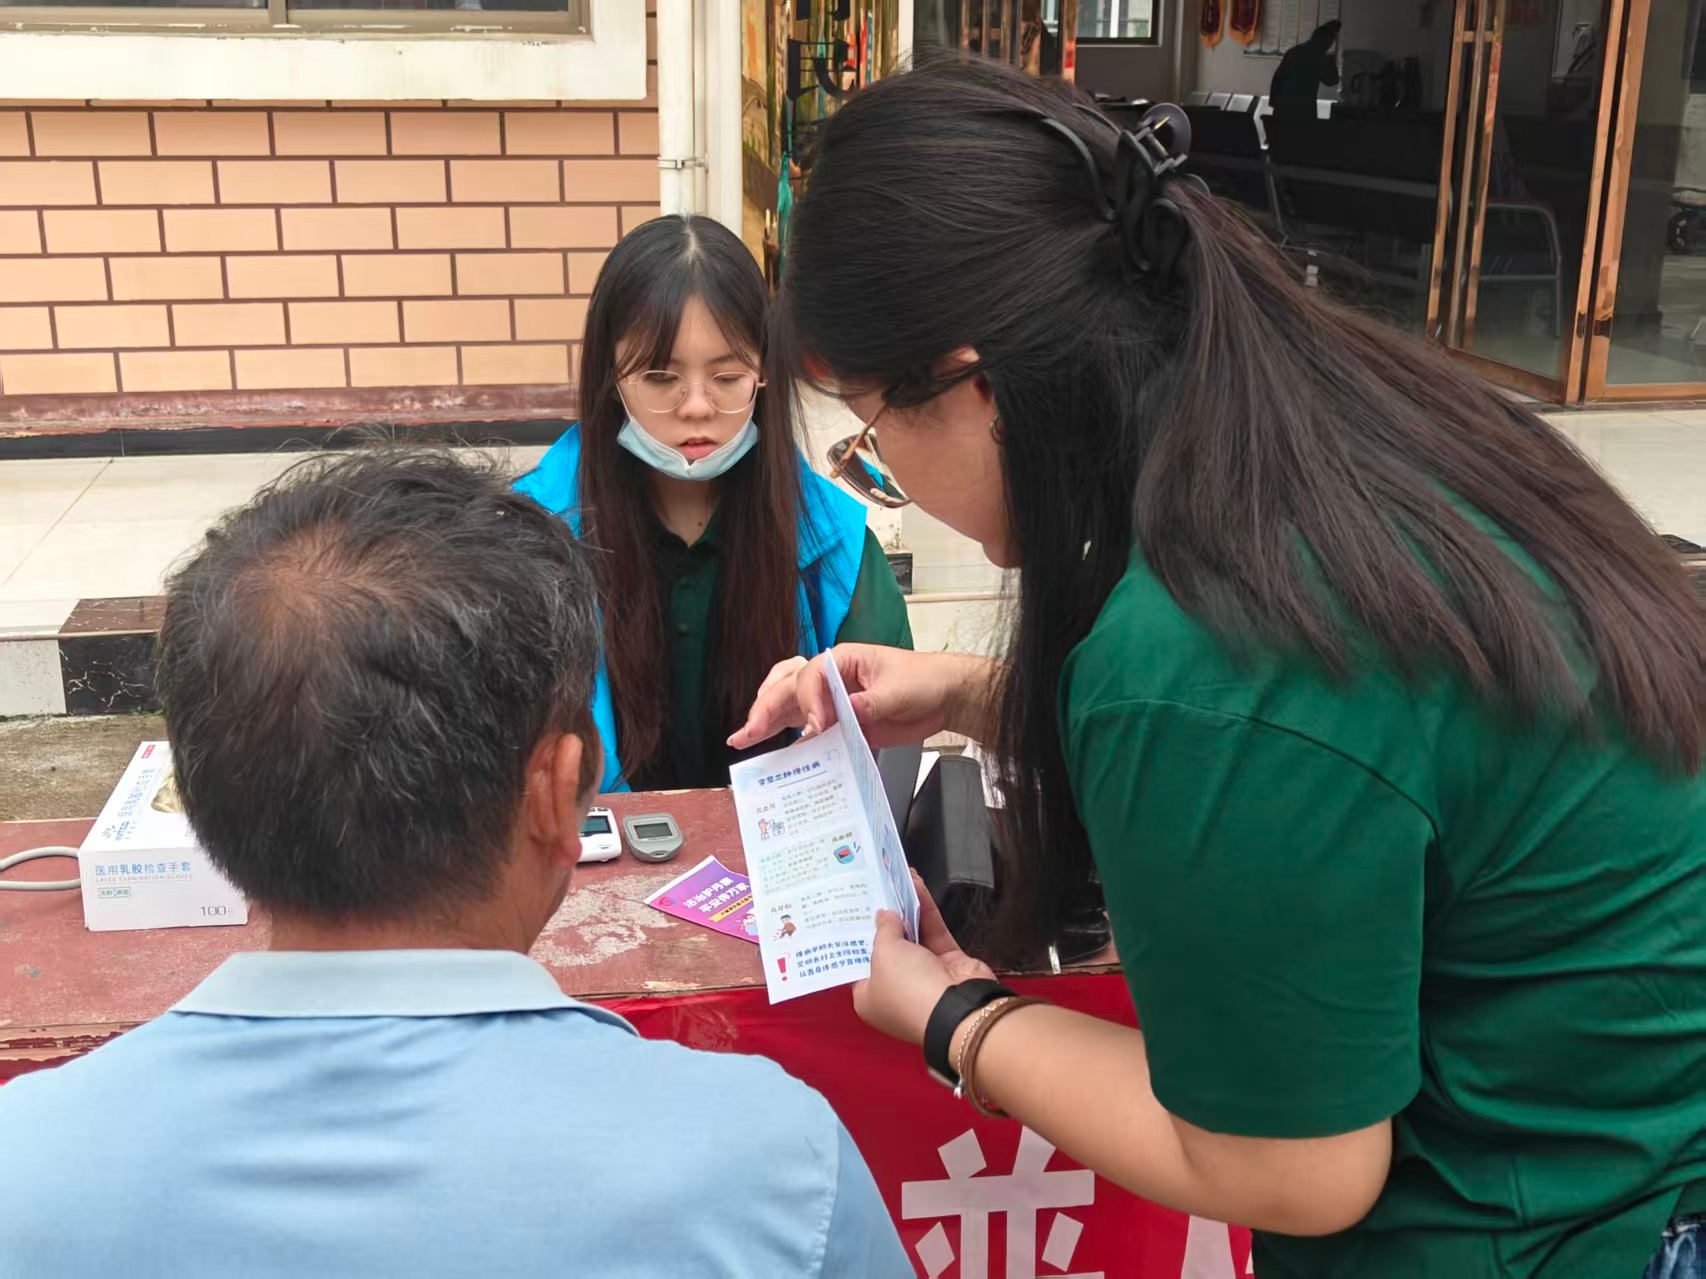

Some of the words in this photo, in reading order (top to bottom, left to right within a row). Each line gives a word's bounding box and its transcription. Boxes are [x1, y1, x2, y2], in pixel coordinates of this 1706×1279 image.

[95, 861, 191, 876] 医用乳胶检查手套
